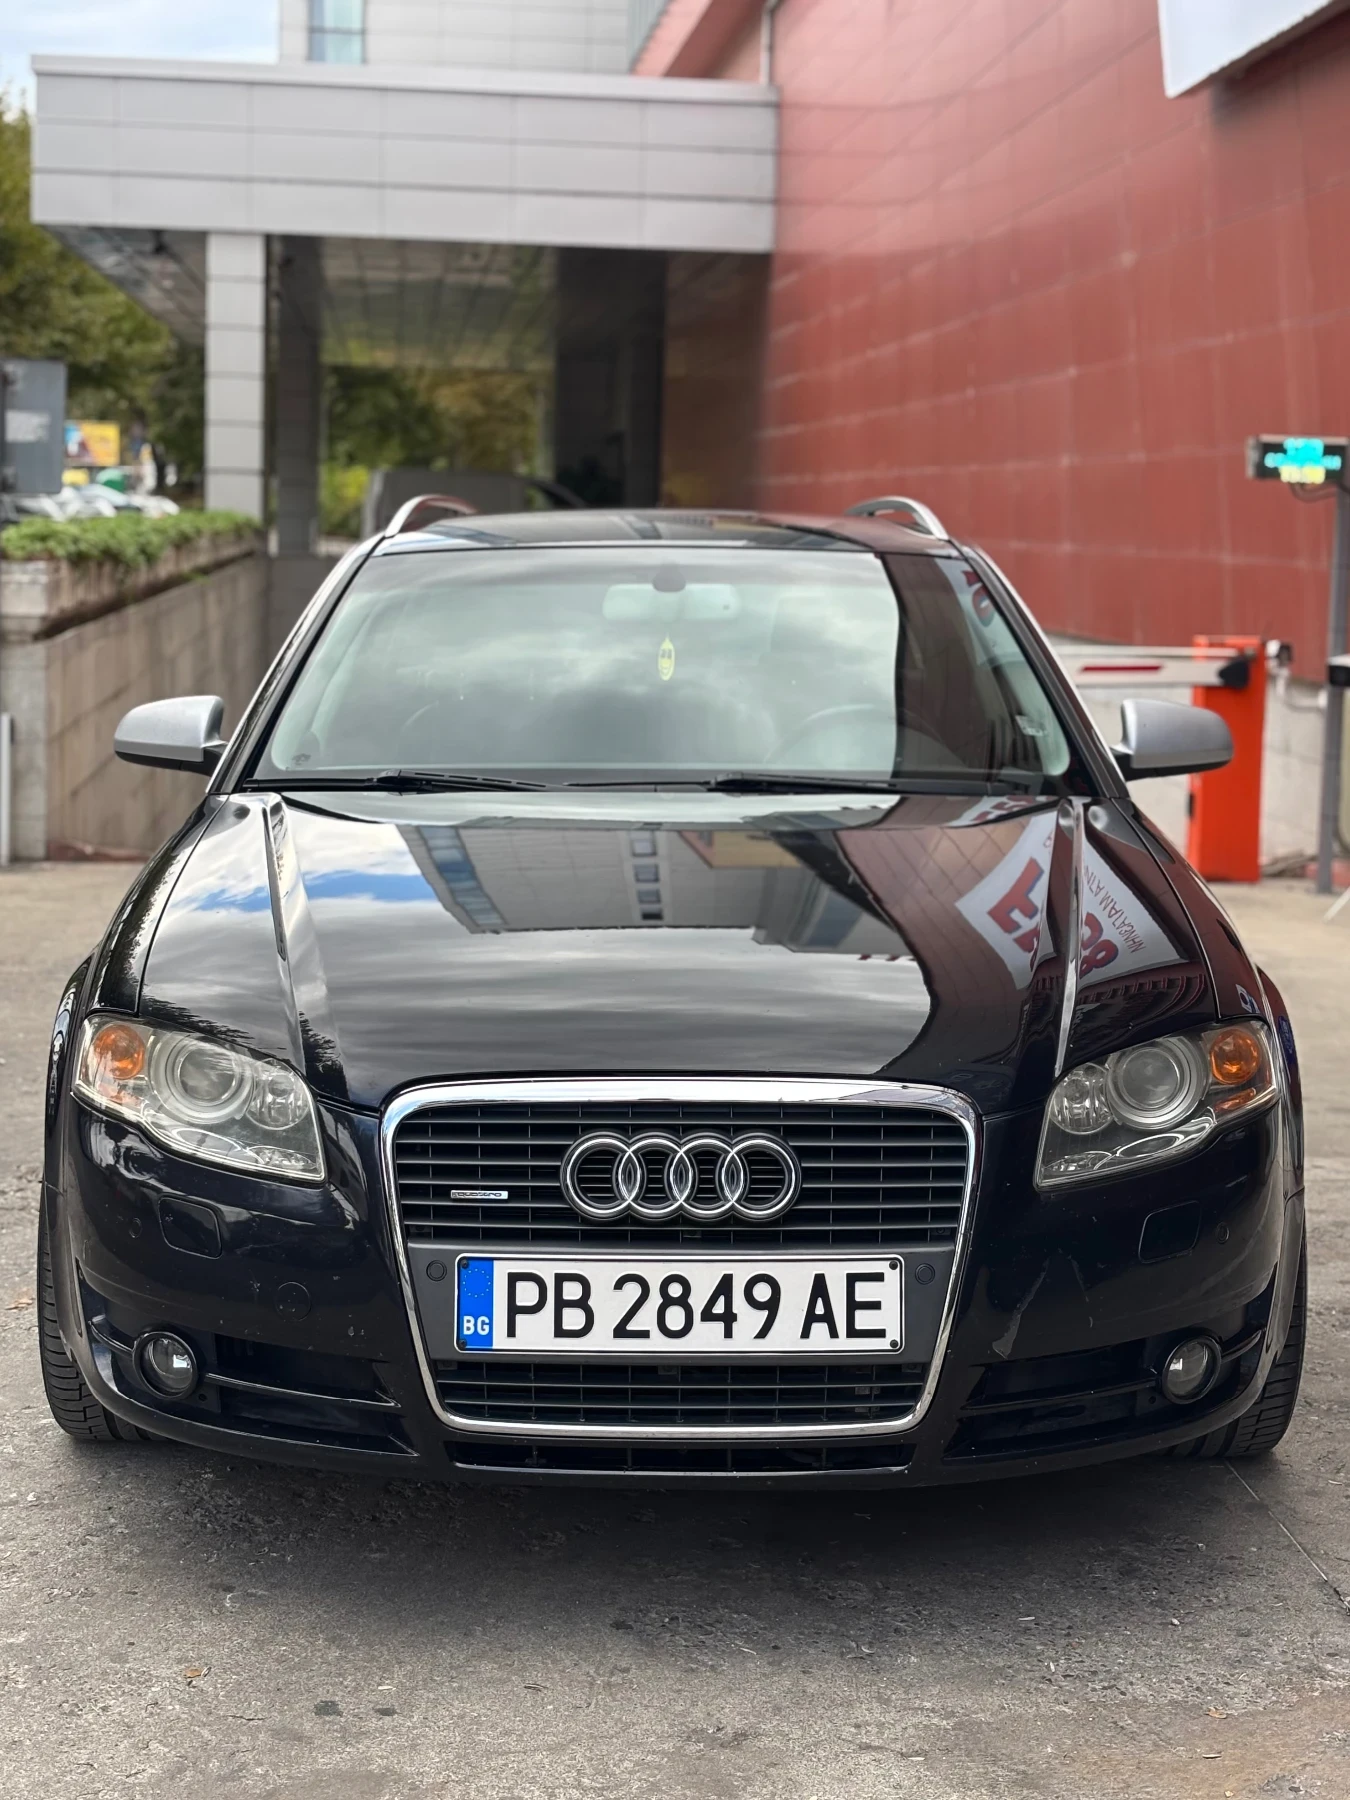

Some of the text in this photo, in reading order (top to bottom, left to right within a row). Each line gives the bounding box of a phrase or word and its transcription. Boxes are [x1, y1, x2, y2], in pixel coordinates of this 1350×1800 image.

[462, 1316, 490, 1336] BG
[507, 1272, 887, 1340] PB 2849 AE
